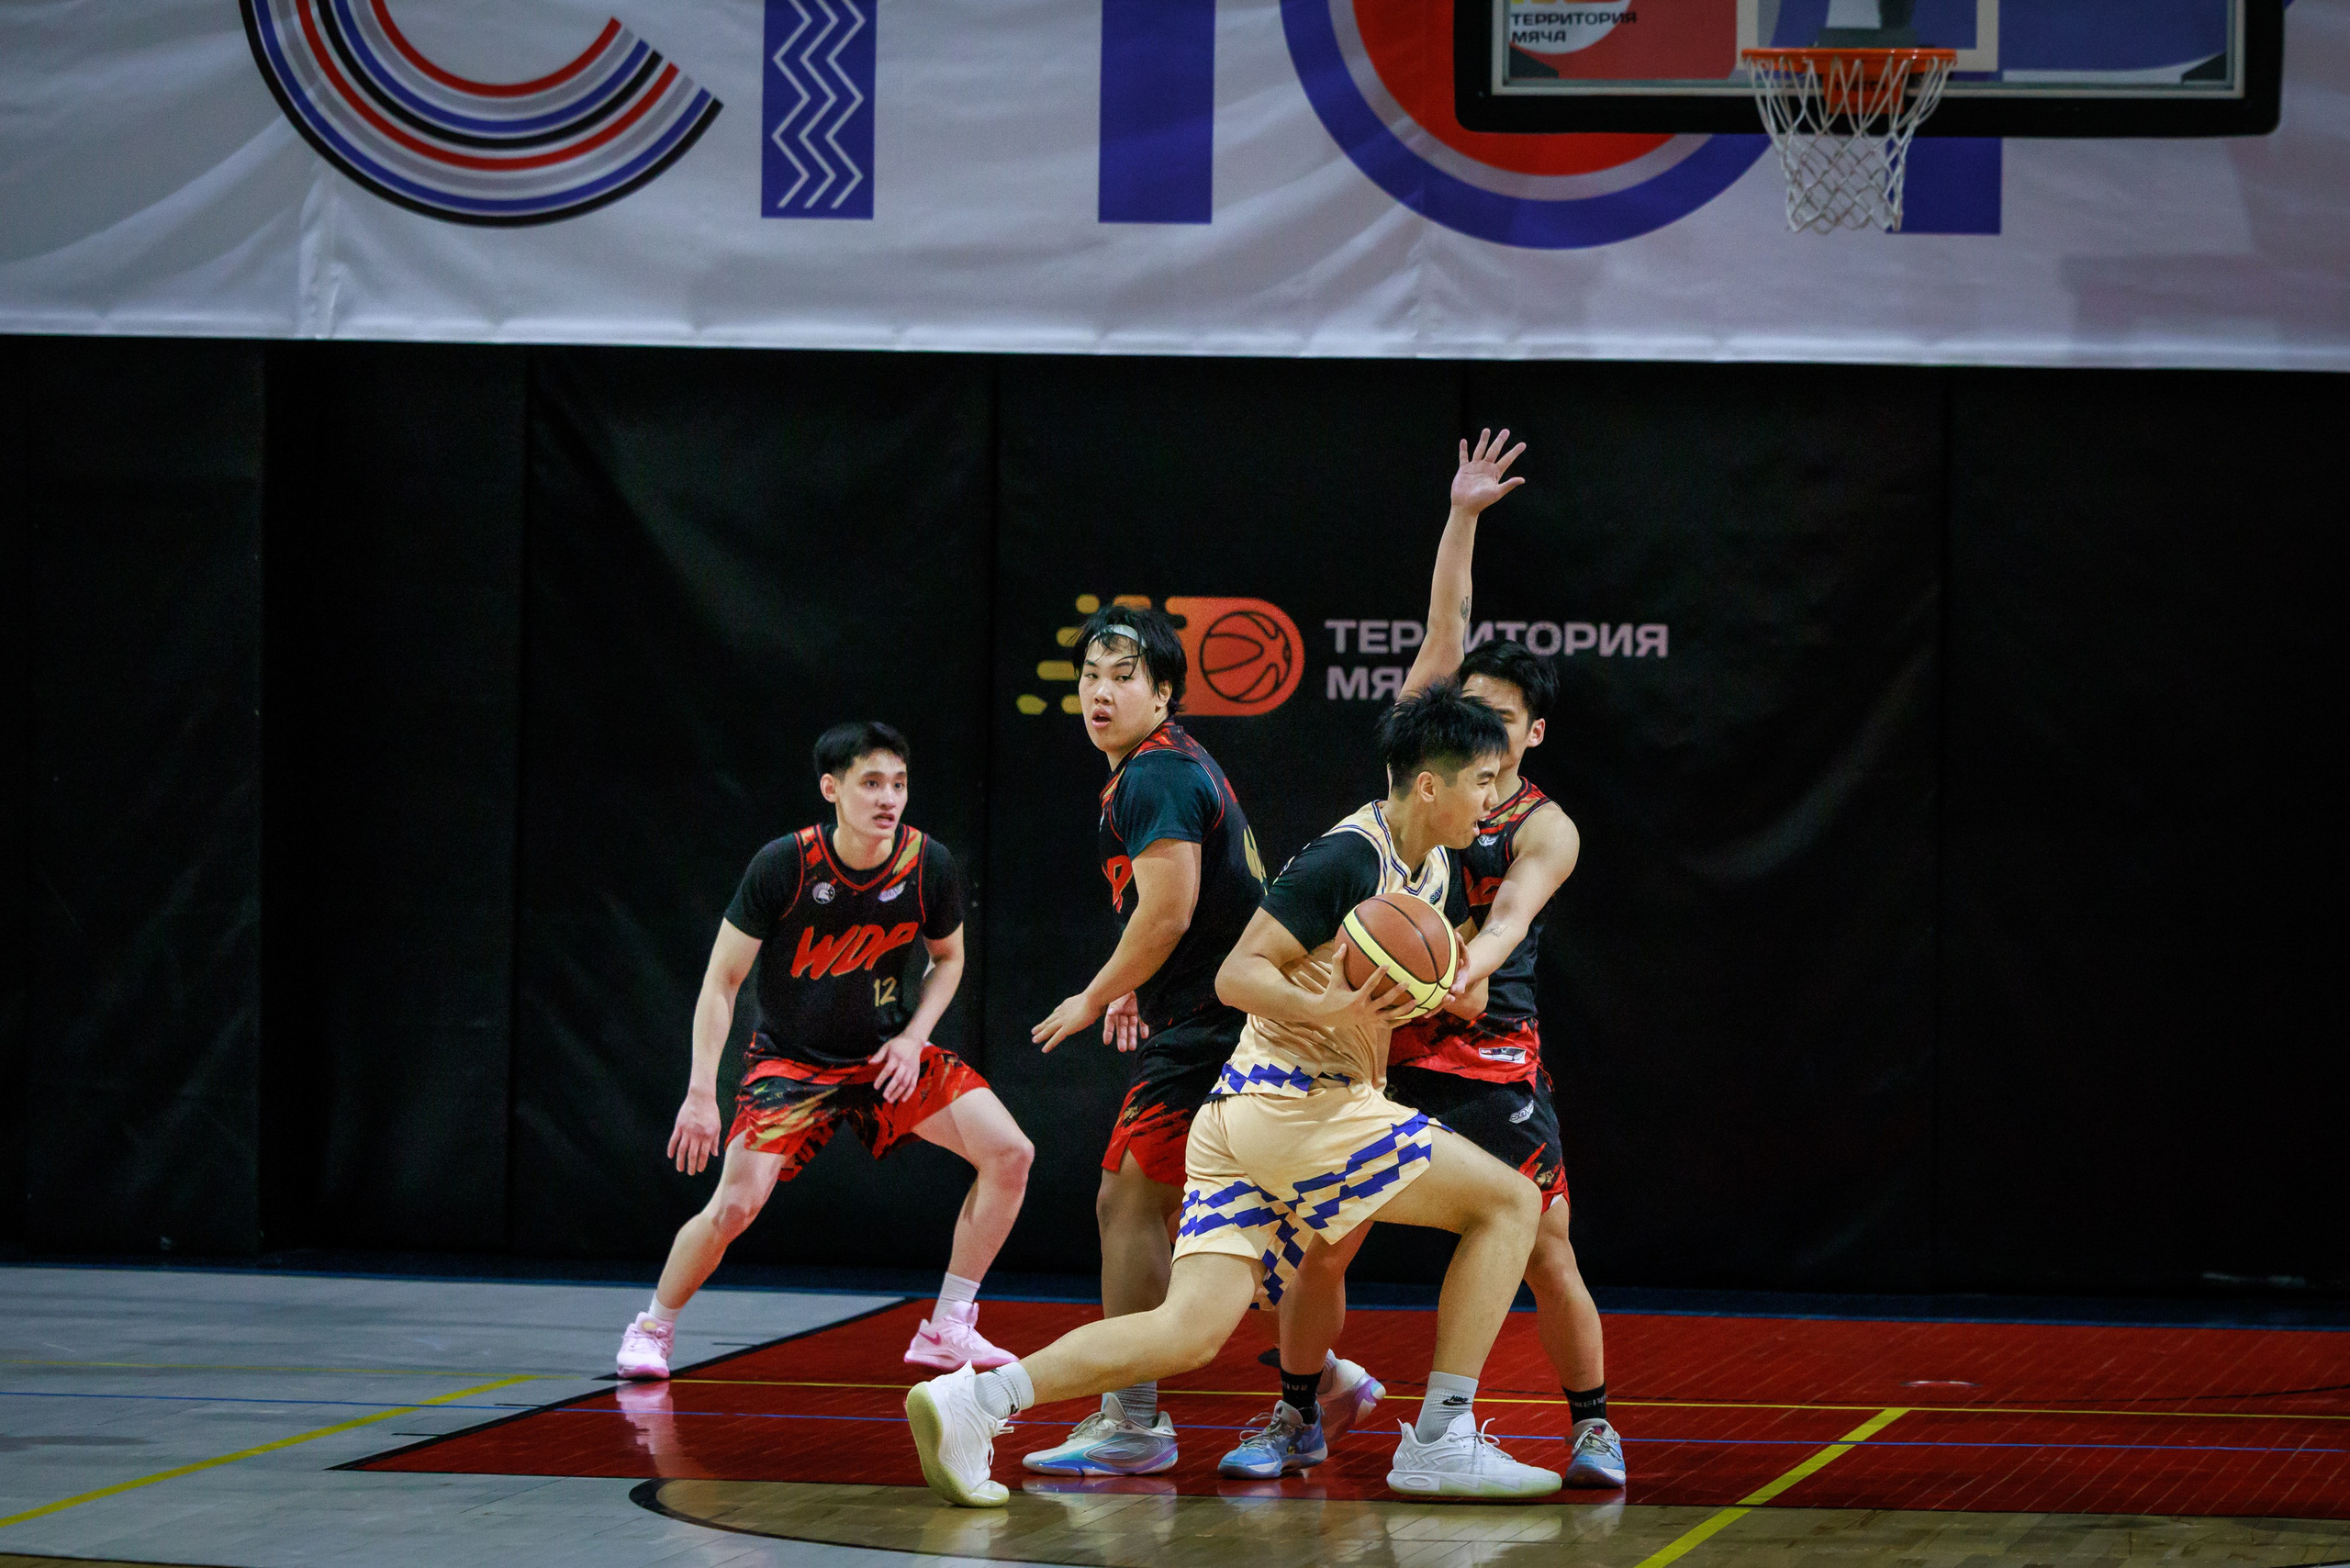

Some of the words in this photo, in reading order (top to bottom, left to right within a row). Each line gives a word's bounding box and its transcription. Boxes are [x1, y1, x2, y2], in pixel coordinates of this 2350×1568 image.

[1511, 12, 1637, 26] ТЕРРИТОРИЯ
[1512, 30, 1567, 43] МЯЧА
[1325, 619, 1669, 657] ТЕРИТОРИЯ
[1326, 666, 1411, 700] МЯ
[790, 922, 919, 980] WDP
[873, 976, 897, 1008] 12
